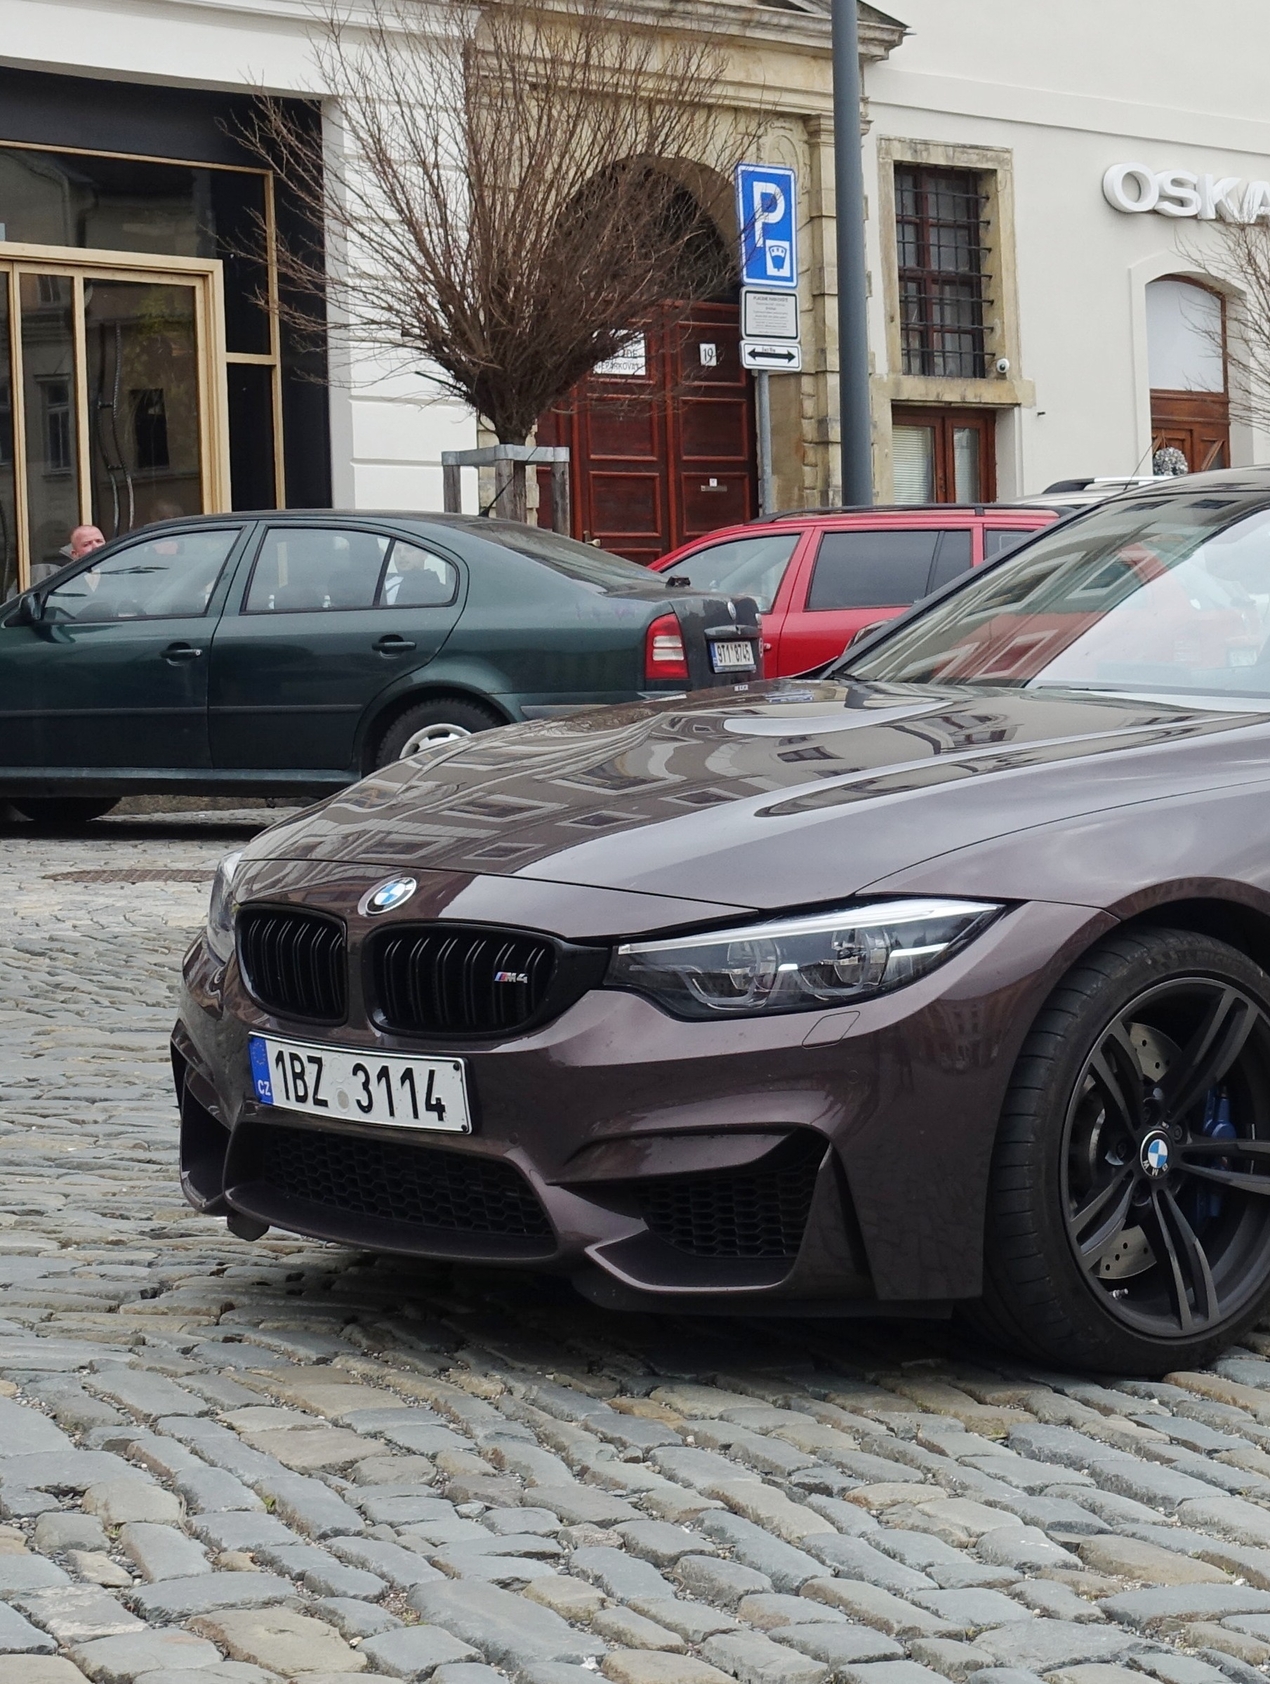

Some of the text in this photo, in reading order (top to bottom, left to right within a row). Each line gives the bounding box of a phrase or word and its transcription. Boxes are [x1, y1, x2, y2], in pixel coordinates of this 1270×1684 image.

[753, 181, 785, 248] P
[703, 347, 714, 361] 19
[497, 971, 528, 984] M4
[258, 1079, 272, 1096] CZ
[275, 1050, 446, 1122] 1BZ 3114
